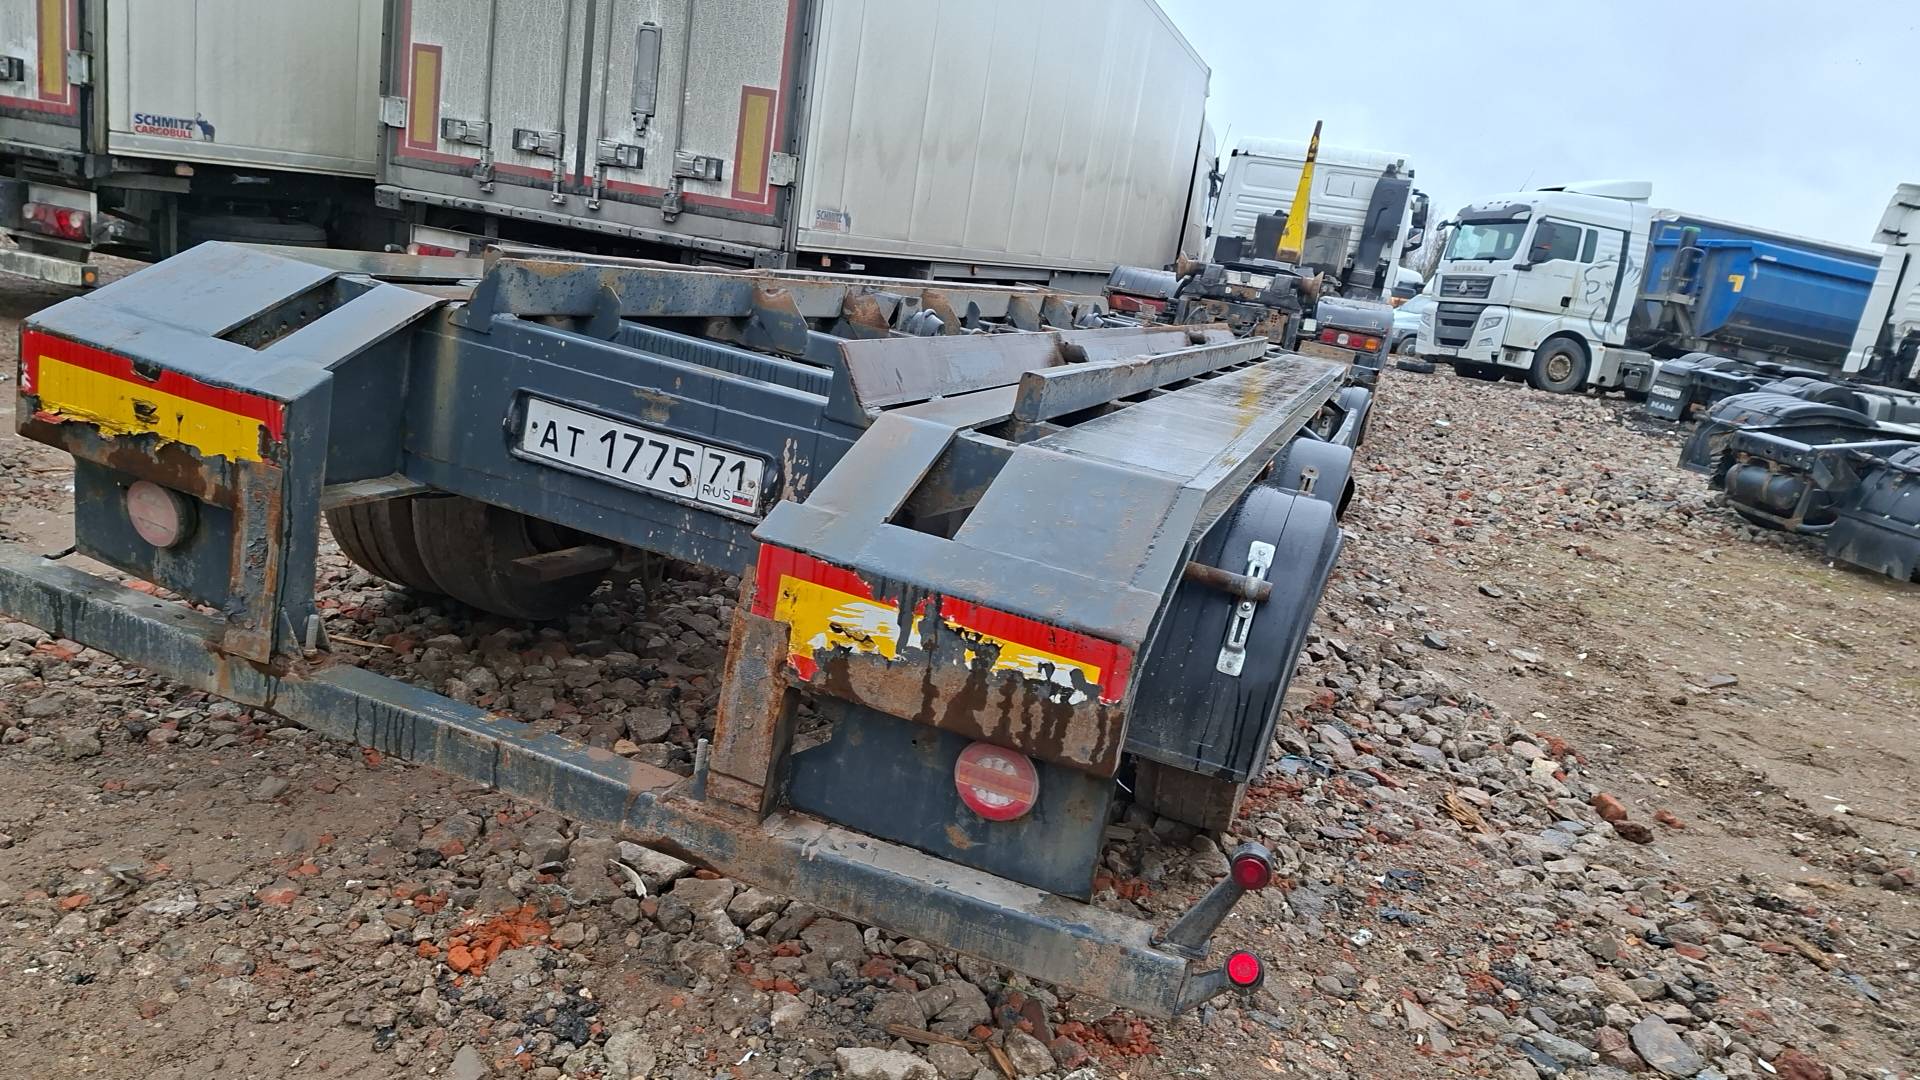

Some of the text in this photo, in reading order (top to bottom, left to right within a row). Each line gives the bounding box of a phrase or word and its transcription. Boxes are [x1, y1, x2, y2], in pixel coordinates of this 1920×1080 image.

[135, 113, 192, 130] SCHMITZ
[135, 125, 192, 138] CARGOBULL
[1651, 400, 1675, 412] MAN
[599, 429, 695, 488] 1775
[708, 453, 746, 491] 71
[702, 483, 731, 501] RUS
